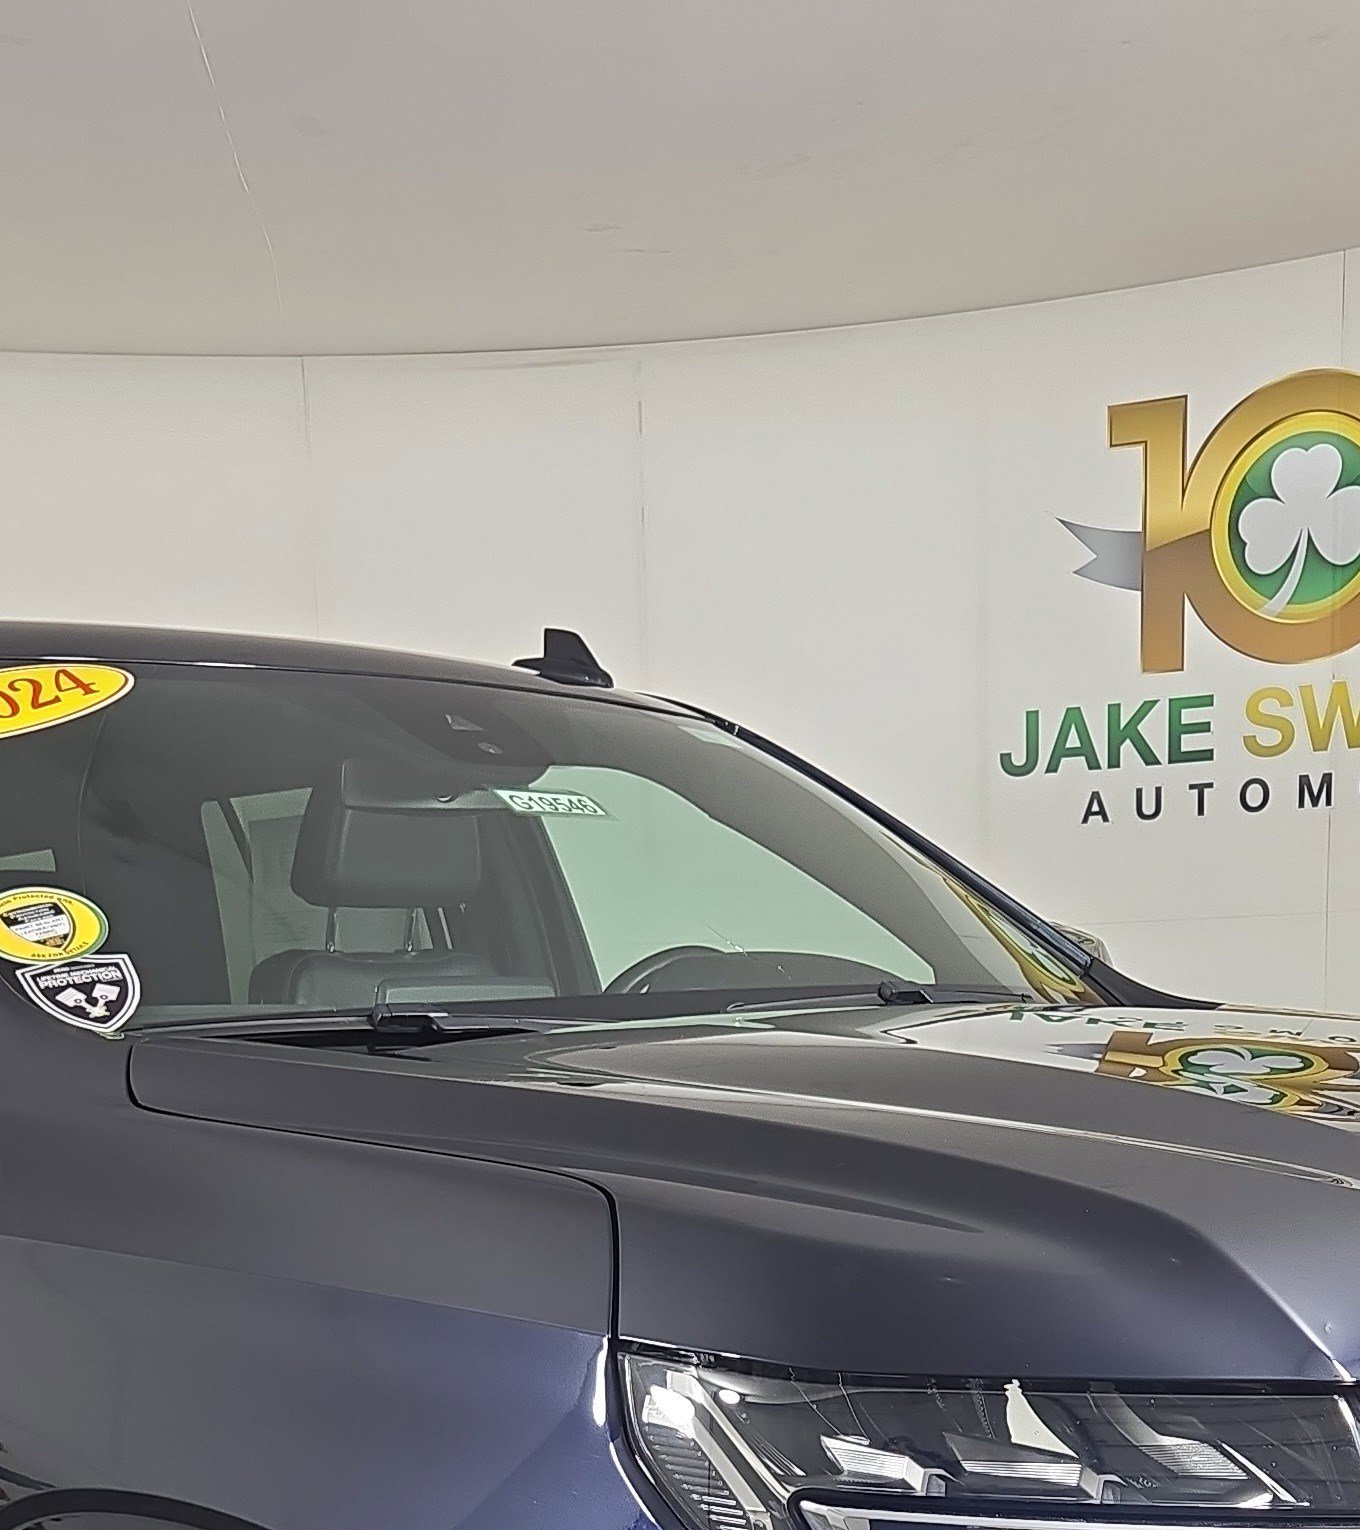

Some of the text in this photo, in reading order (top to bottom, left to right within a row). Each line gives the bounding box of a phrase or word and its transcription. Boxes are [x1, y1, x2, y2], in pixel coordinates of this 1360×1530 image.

[998, 695, 1215, 777] JAKE
[507, 794, 597, 814] G19546
[39, 968, 123, 989] PROTECTION
